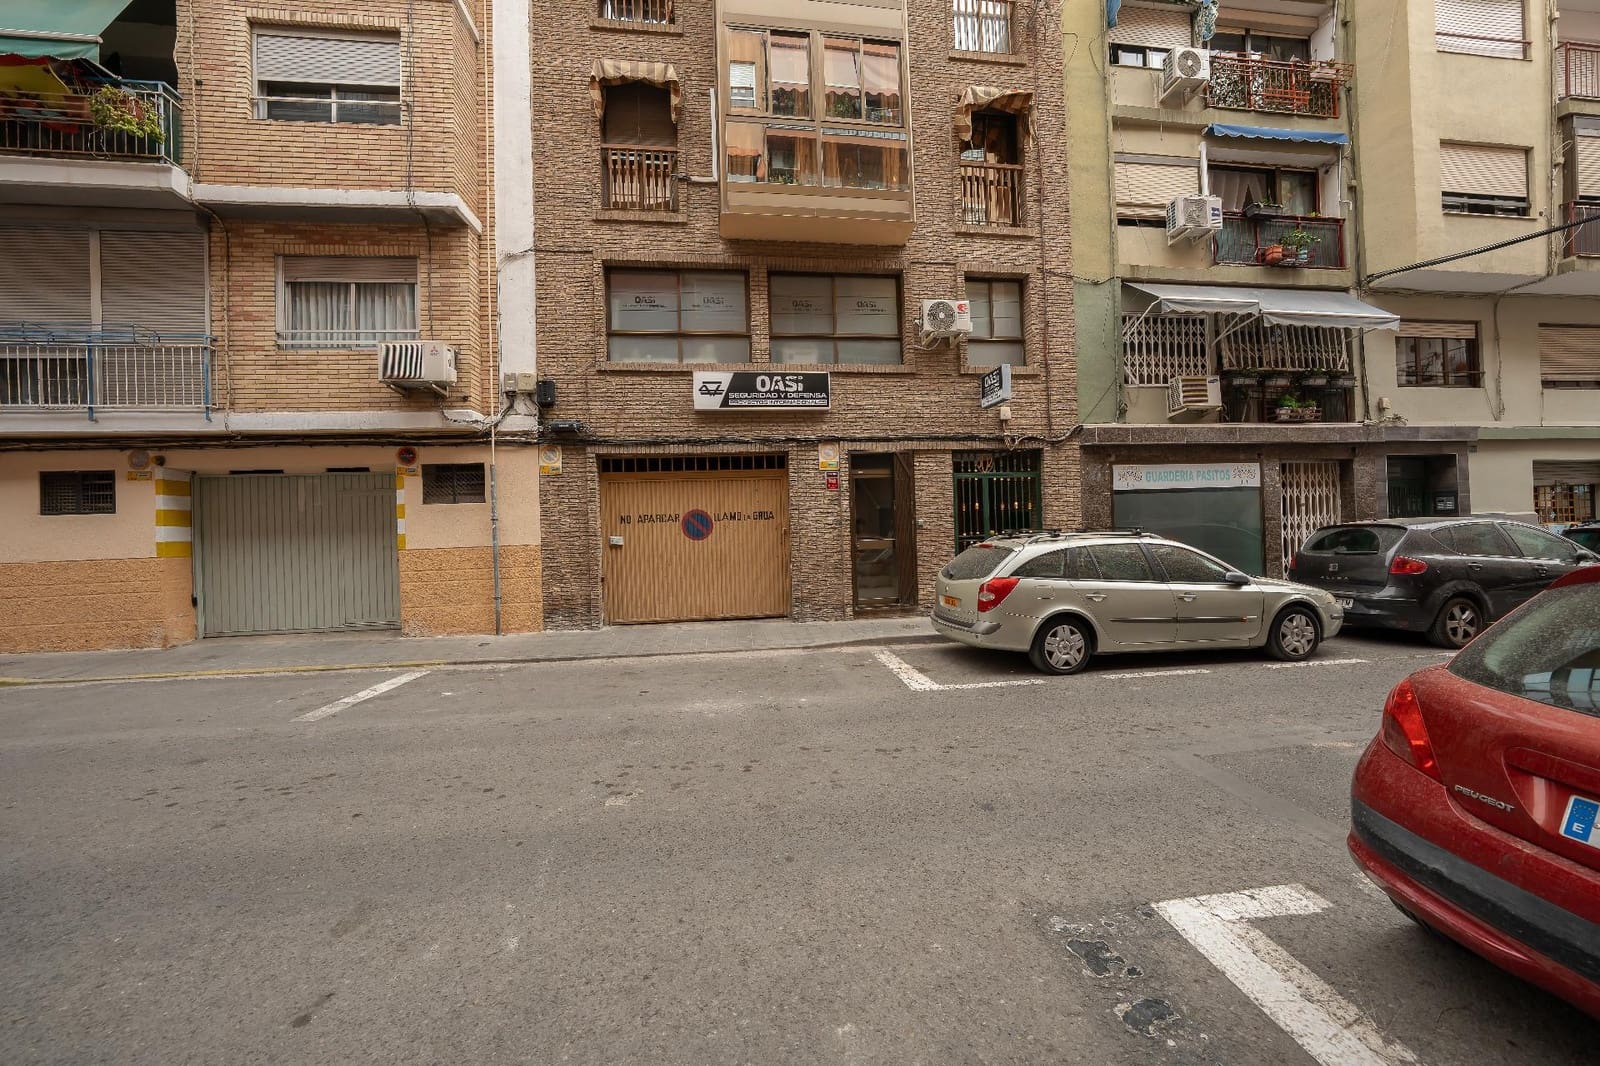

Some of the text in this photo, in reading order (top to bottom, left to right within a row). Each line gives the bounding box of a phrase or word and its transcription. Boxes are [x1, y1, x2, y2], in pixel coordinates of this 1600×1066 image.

[1196, 468, 1231, 481] PASITOS
[620, 514, 632, 525] NO
[637, 513, 680, 524] APARCAR
[713, 511, 742, 522] LLAMO
[752, 511, 775, 521] GRUA
[1454, 784, 1516, 813] PEUGEOT
